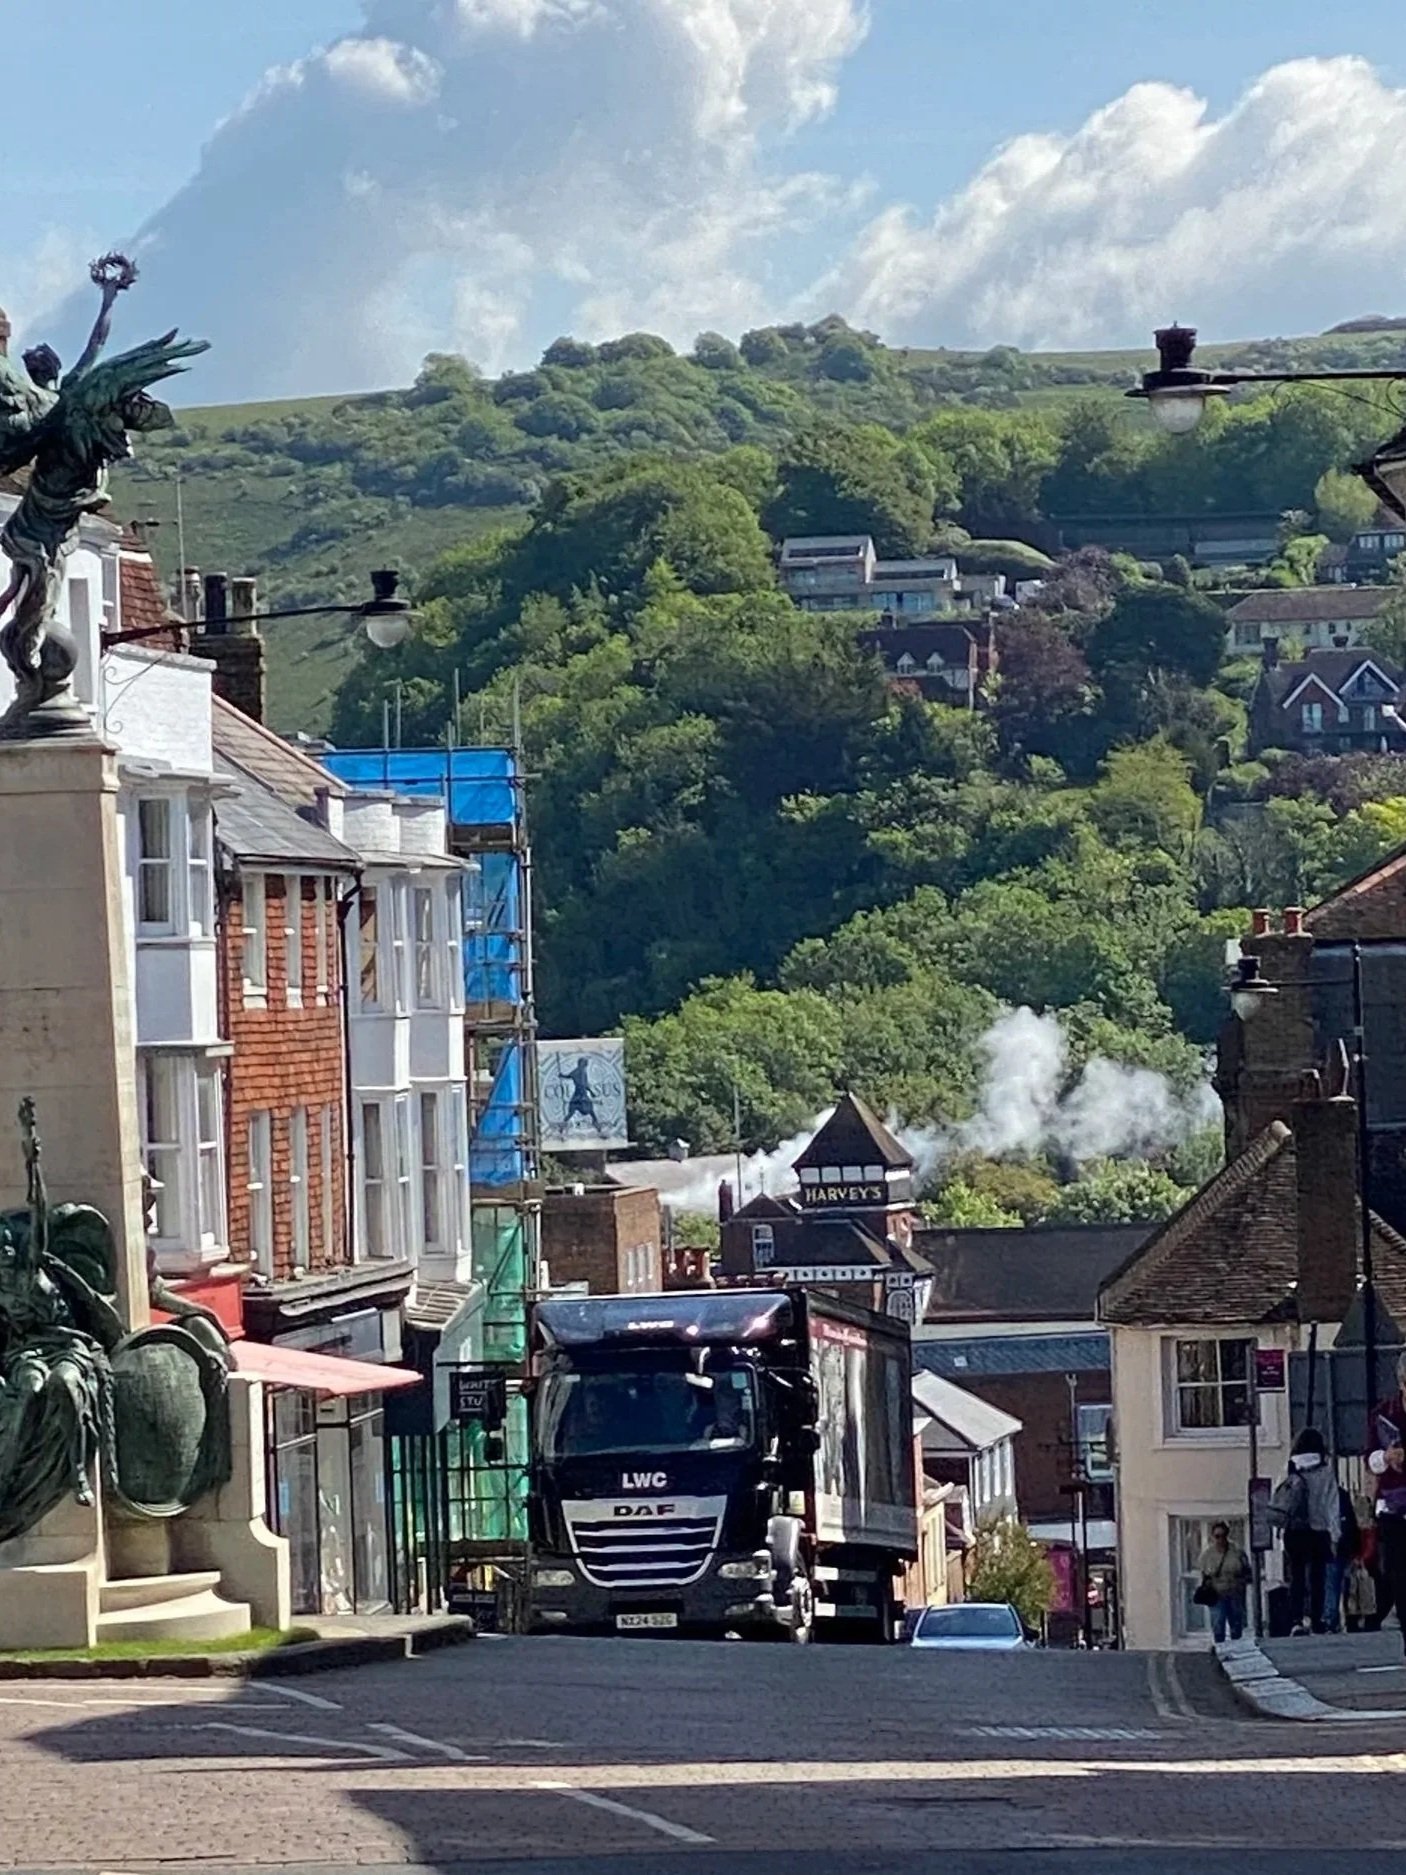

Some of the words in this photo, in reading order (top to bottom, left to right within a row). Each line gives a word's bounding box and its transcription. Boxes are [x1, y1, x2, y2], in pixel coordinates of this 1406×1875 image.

[805, 1185, 882, 1202] HARVEY'S
[622, 1471, 668, 1489] LWC
[614, 1504, 675, 1516] DAF
